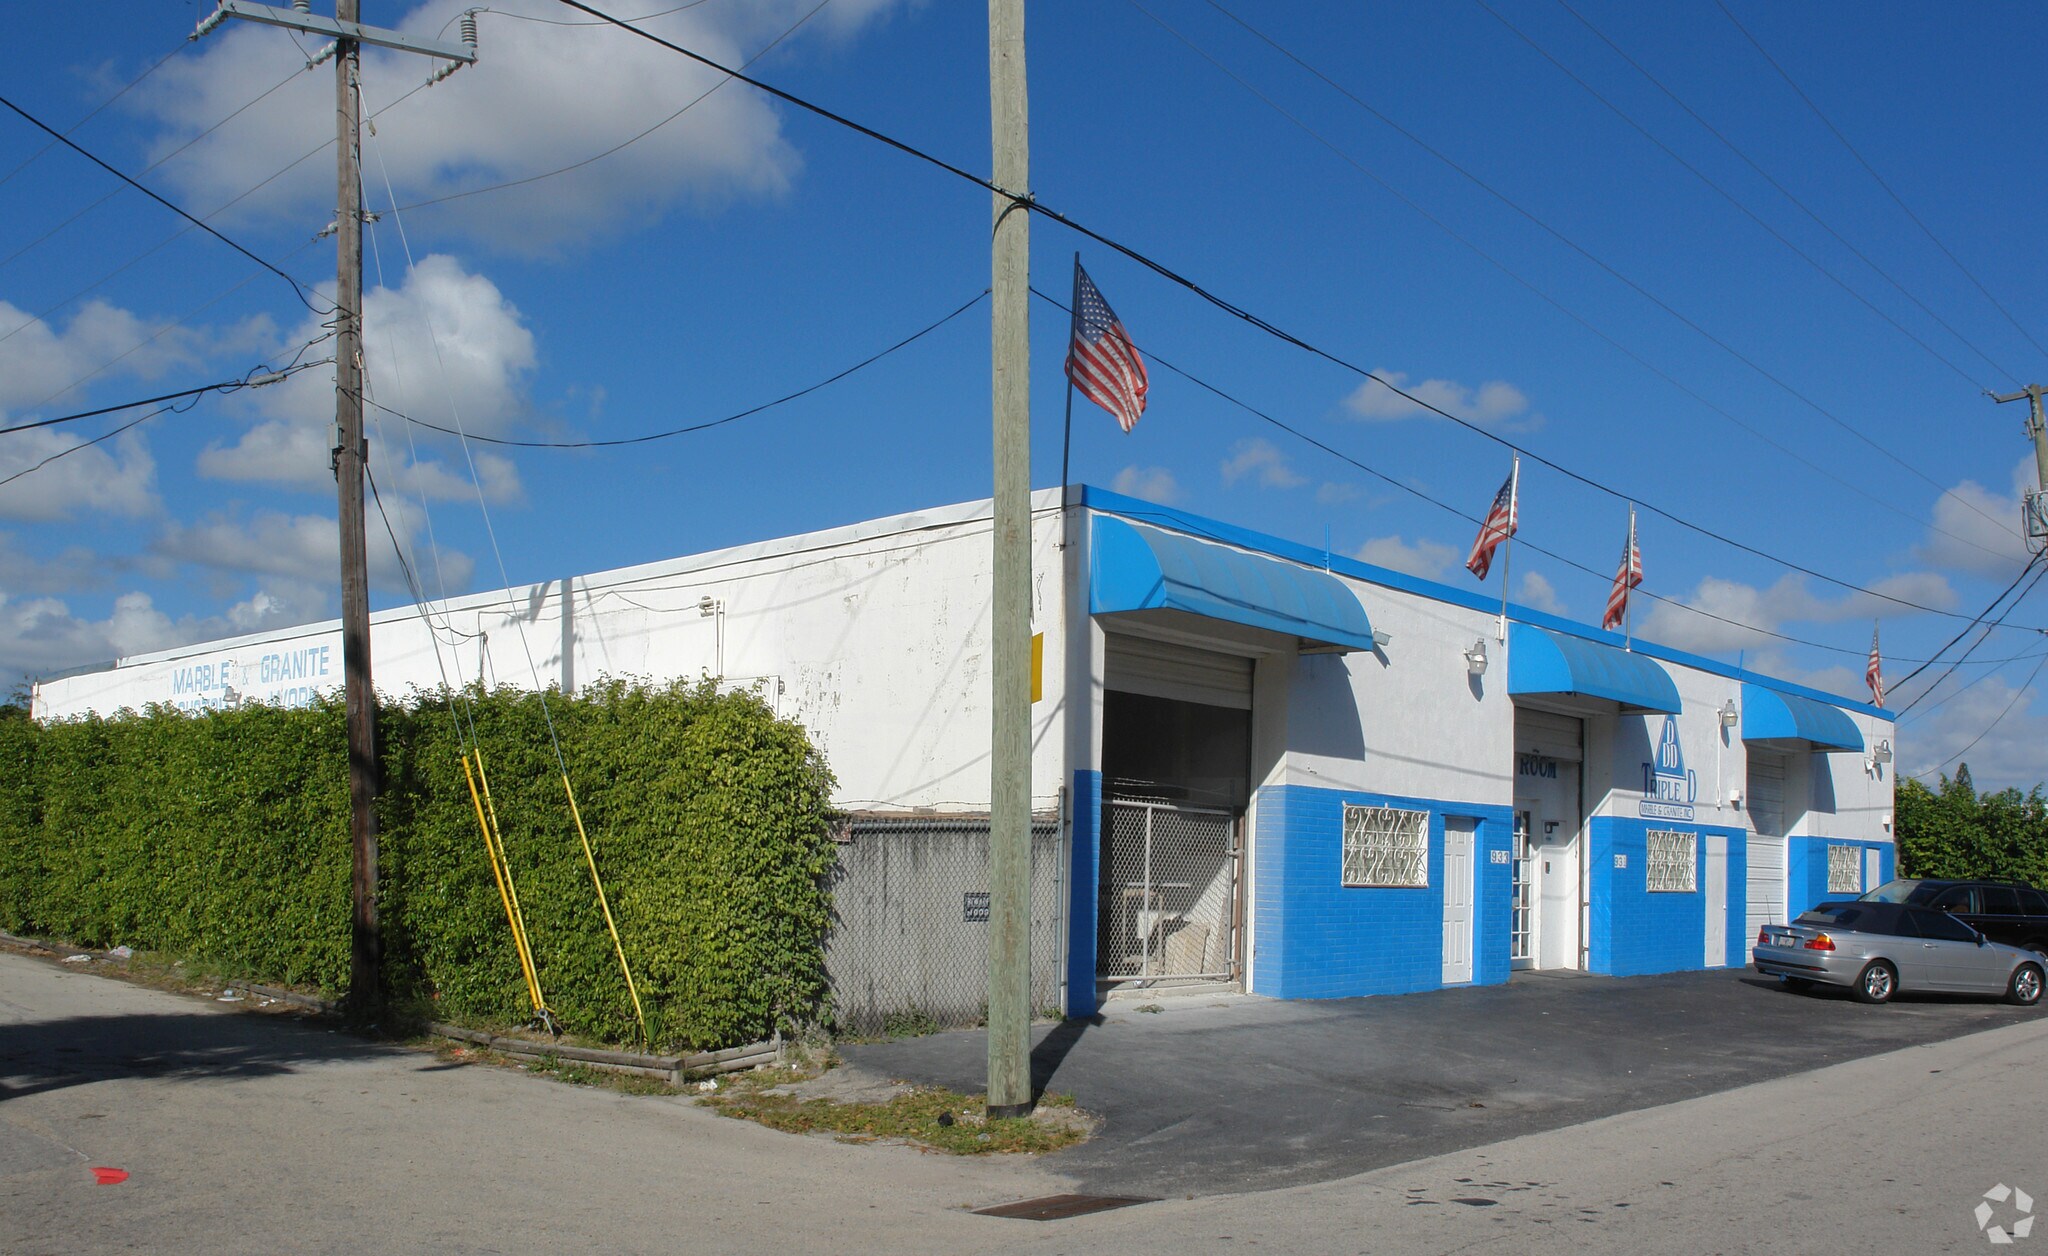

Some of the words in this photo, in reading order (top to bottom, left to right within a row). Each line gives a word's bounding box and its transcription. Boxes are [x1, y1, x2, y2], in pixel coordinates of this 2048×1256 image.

[173, 662, 230, 694] MARBLE
[260, 646, 329, 684] GRANITE
[1688, 769, 1697, 803] D
[1491, 851, 1509, 863] 933
